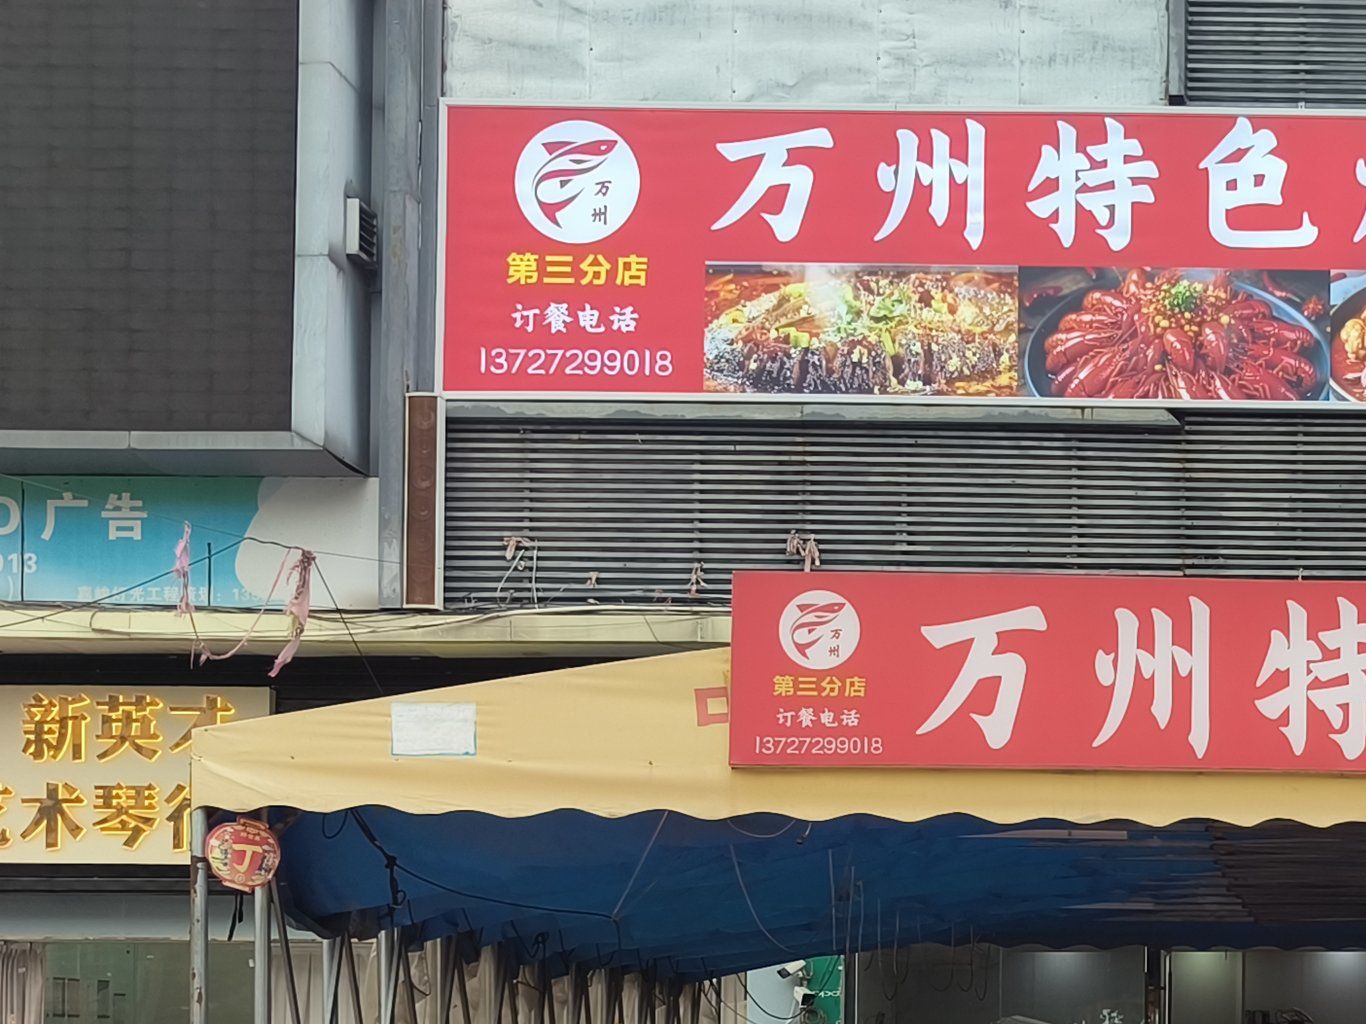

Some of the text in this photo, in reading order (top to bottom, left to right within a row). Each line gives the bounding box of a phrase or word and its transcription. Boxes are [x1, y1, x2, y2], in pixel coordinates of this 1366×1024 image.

[592, 181, 611, 225] 万州
[506, 252, 649, 287] 第三分店
[511, 302, 640, 334] 订餐电话
[479, 347, 673, 377] 13727299018
[828, 628, 842, 658] 万州
[772, 675, 867, 698] 第三分店
[775, 706, 861, 729] 订餐电话
[754, 734, 884, 755] 13727299018
